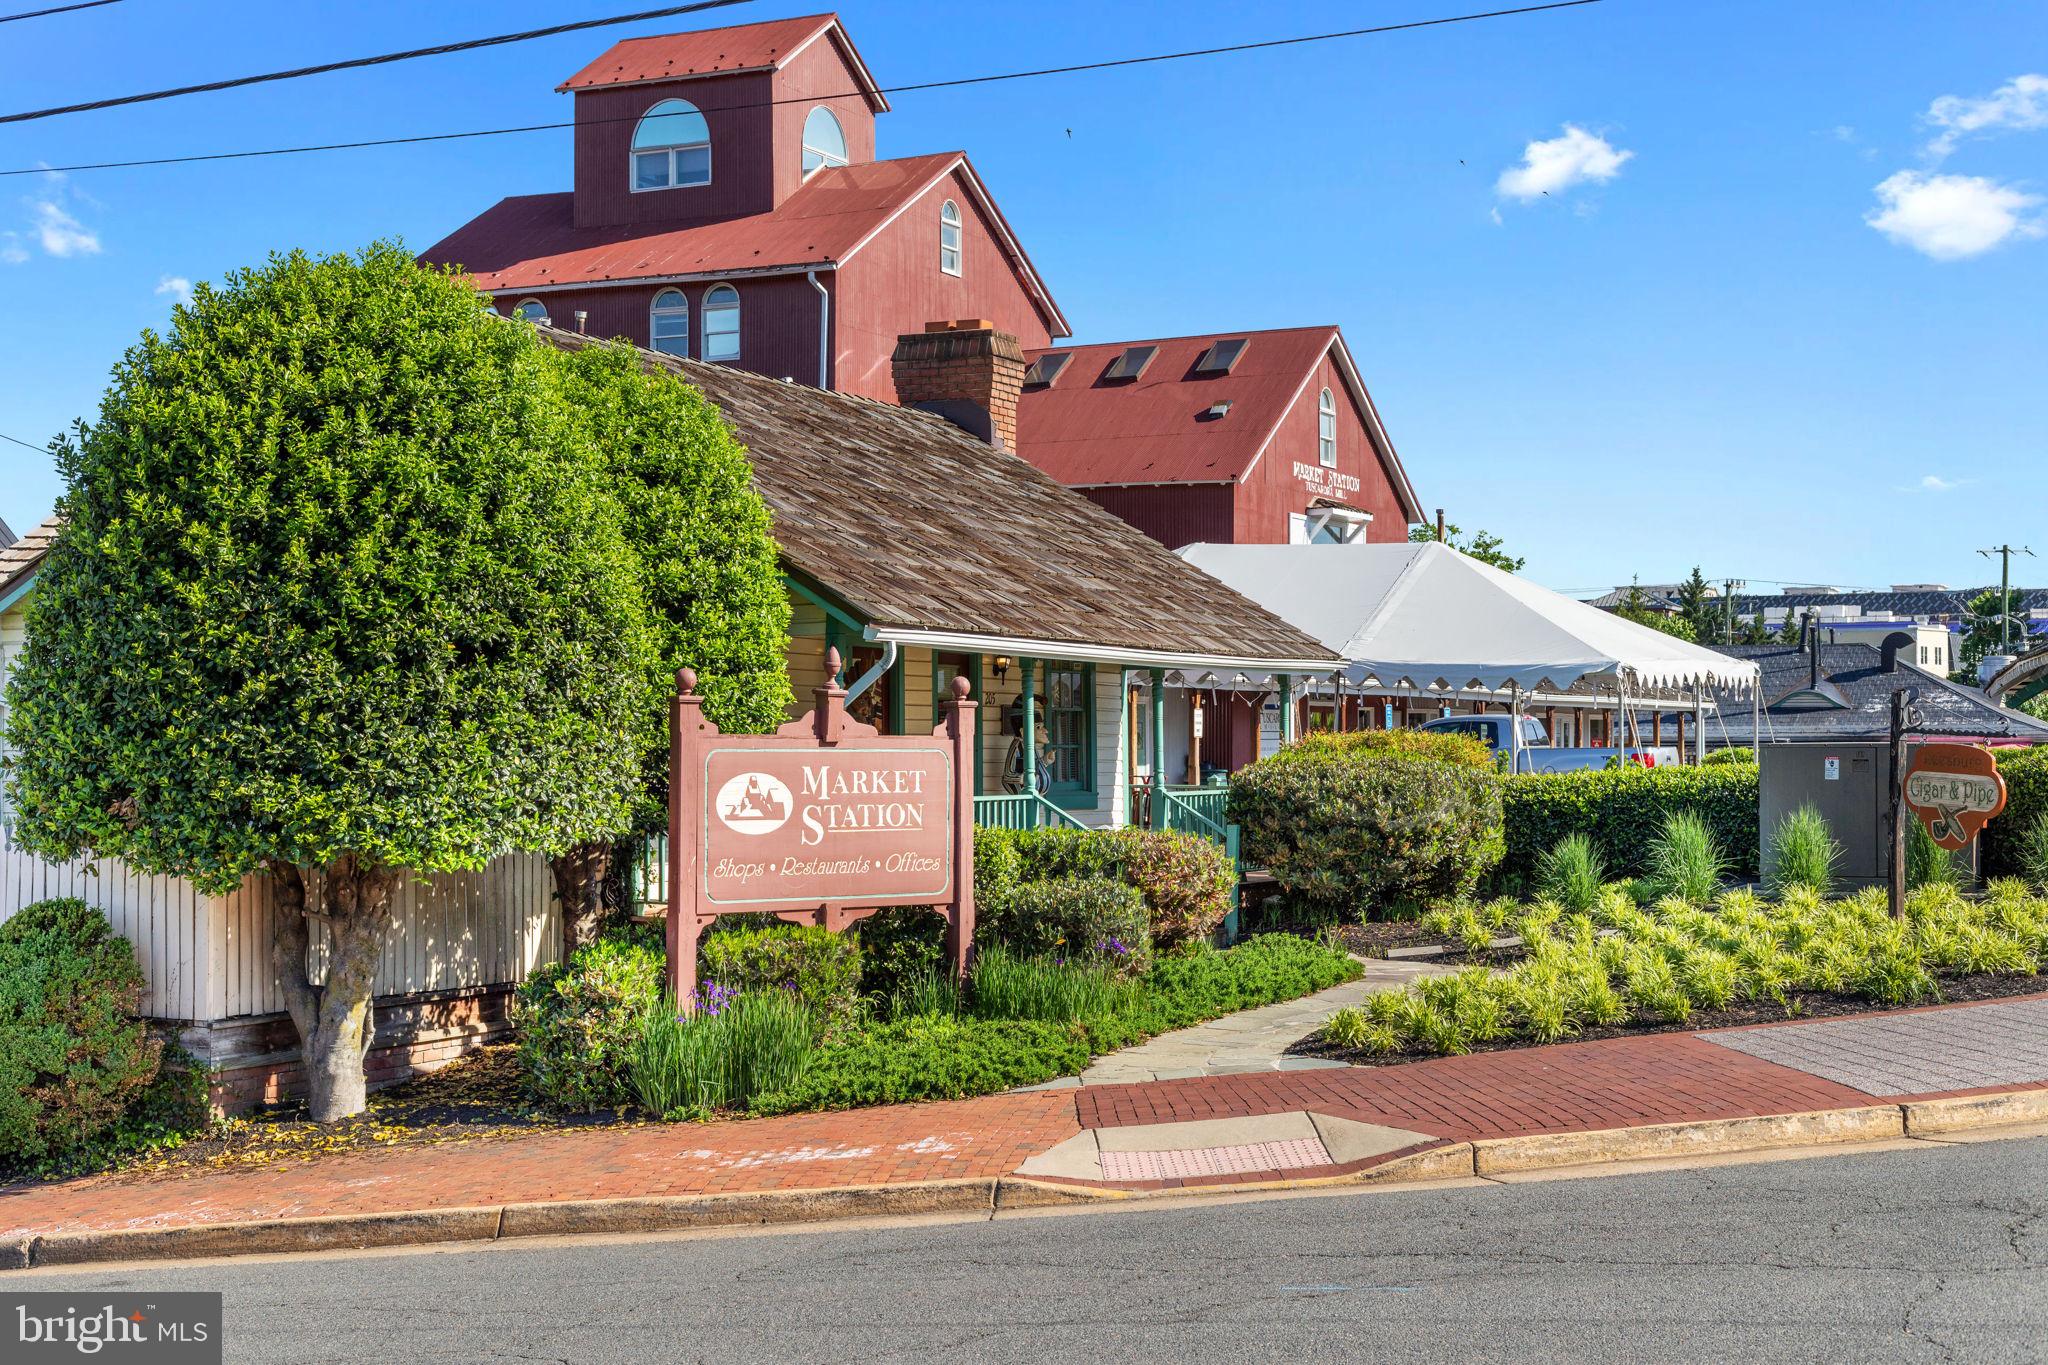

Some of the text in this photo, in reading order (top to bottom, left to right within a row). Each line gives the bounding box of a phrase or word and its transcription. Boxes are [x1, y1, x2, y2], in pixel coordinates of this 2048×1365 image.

[1293, 461, 1361, 492] MARKET STATION
[985, 691, 996, 704] 205
[801, 766, 926, 800] MARKET
[1910, 774, 1995, 807] Cigar & Pipe
[801, 803, 925, 845] STATION
[713, 851, 941, 884] Shops Restaurants Offices
